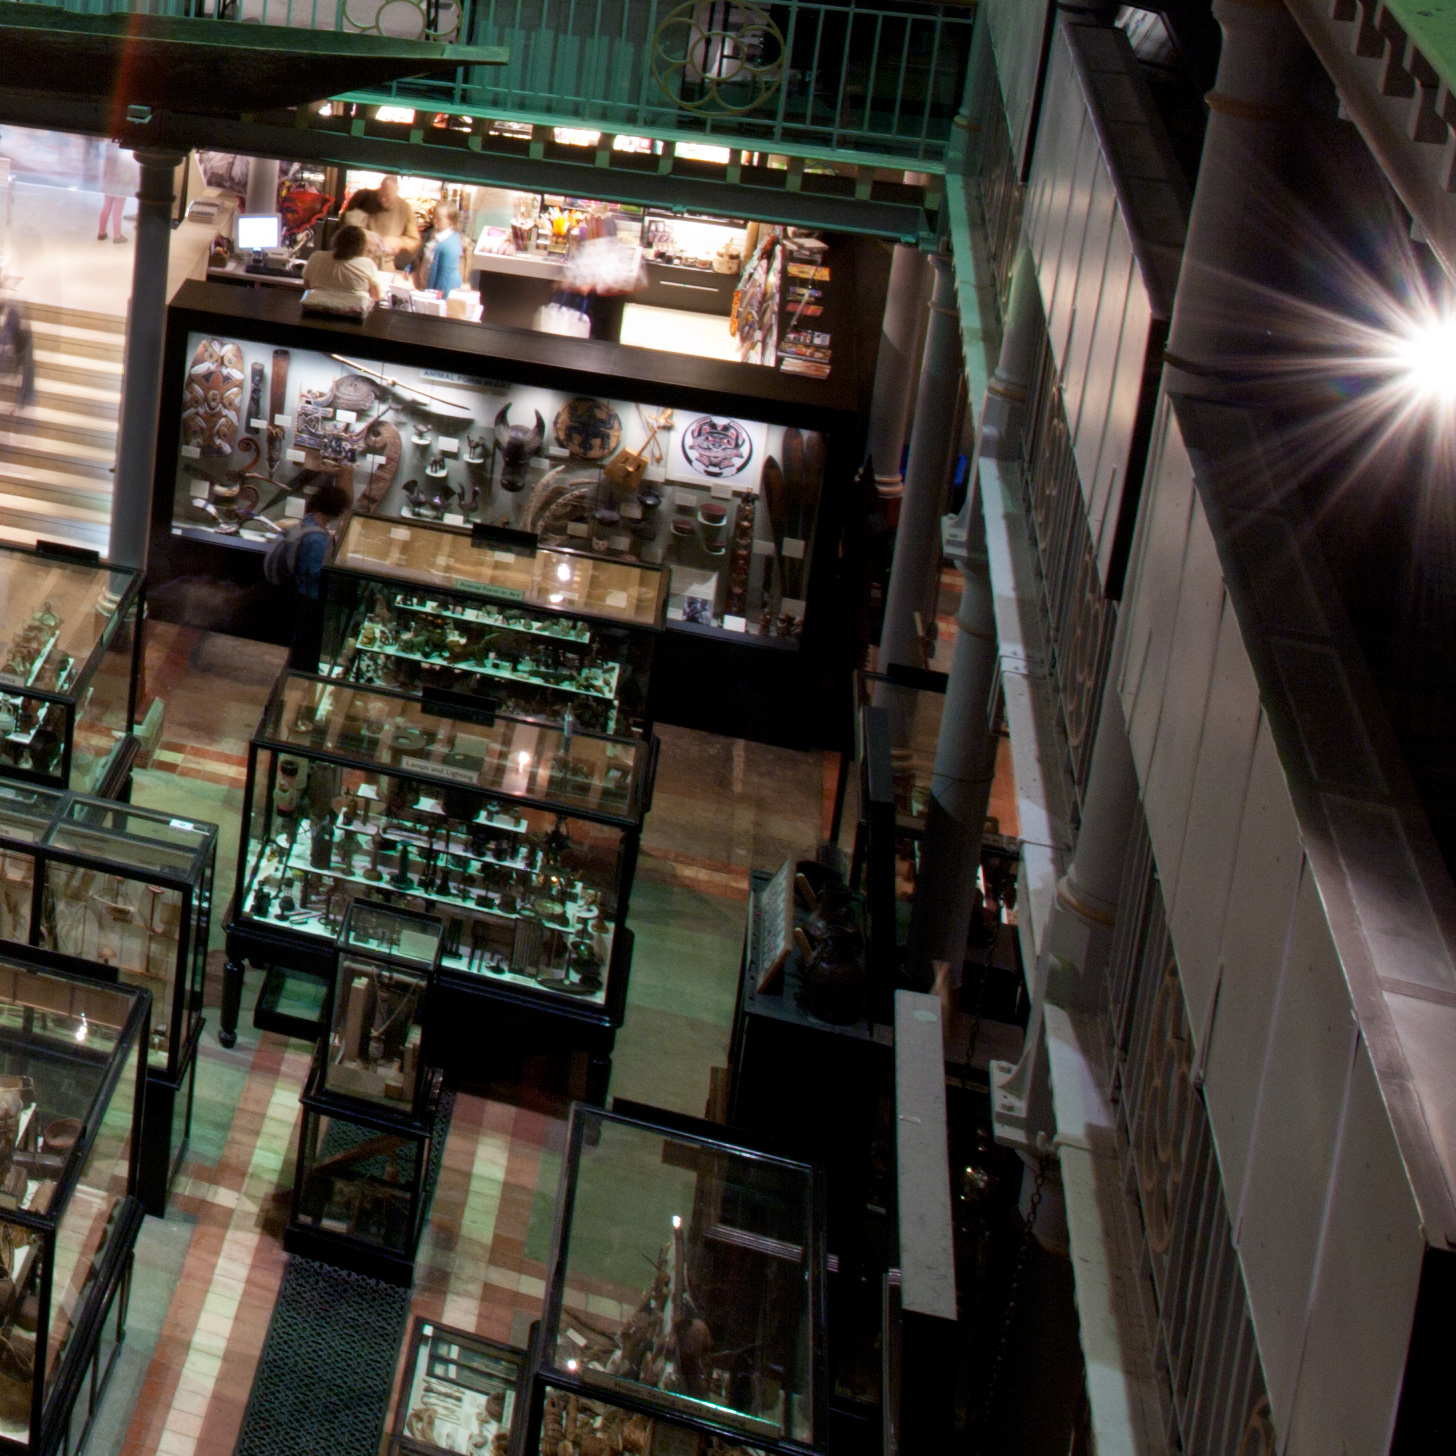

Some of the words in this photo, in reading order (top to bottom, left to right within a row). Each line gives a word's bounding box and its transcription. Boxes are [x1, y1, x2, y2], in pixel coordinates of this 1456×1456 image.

[423, 369, 454, 380] ANIMAL
[459, 581, 481, 590] Animal
[406, 760, 429, 772] Lamps
[431, 766, 444, 774] and
[446, 767, 473, 781] Lighting
[682, 1403, 701, 1412] and
